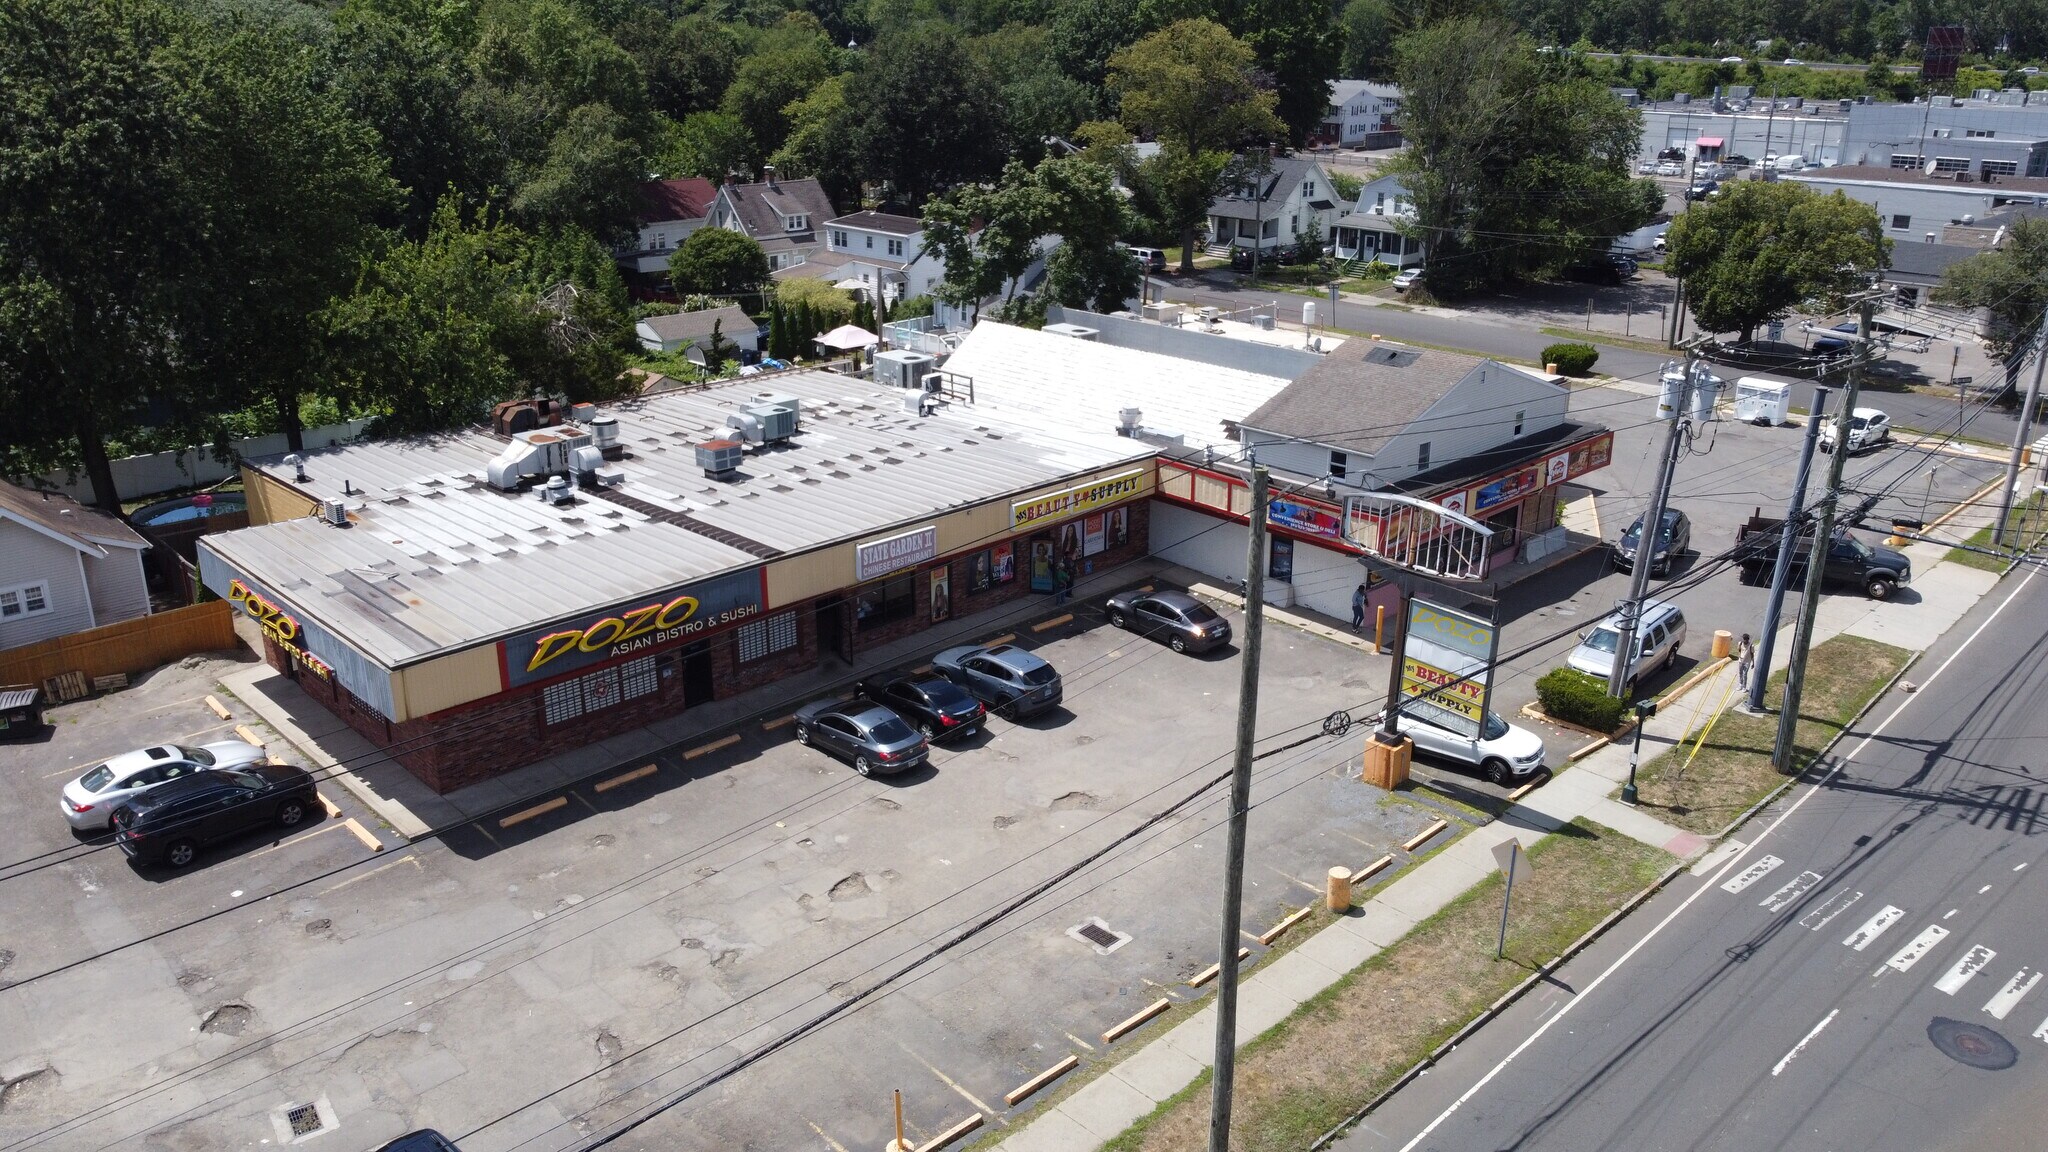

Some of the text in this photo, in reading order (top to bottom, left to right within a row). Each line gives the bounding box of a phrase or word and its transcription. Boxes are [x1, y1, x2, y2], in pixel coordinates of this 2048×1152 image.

[1027, 493, 1081, 520] BEAUTY
[1090, 477, 1138, 502] SUPPLY
[863, 532, 932, 565] STATE GARDEN II
[863, 560, 891, 576] CHINESE
[892, 549, 932, 569] RESTAURANT
[229, 580, 296, 640] DOZO
[1411, 607, 1490, 645] DOZO
[527, 596, 699, 672] DOZO
[611, 603, 758, 657] ASIAN BISTRO & SUSHI
[1415, 665, 1480, 698] BEAUTY
[1420, 688, 1472, 715] SUPPLY
